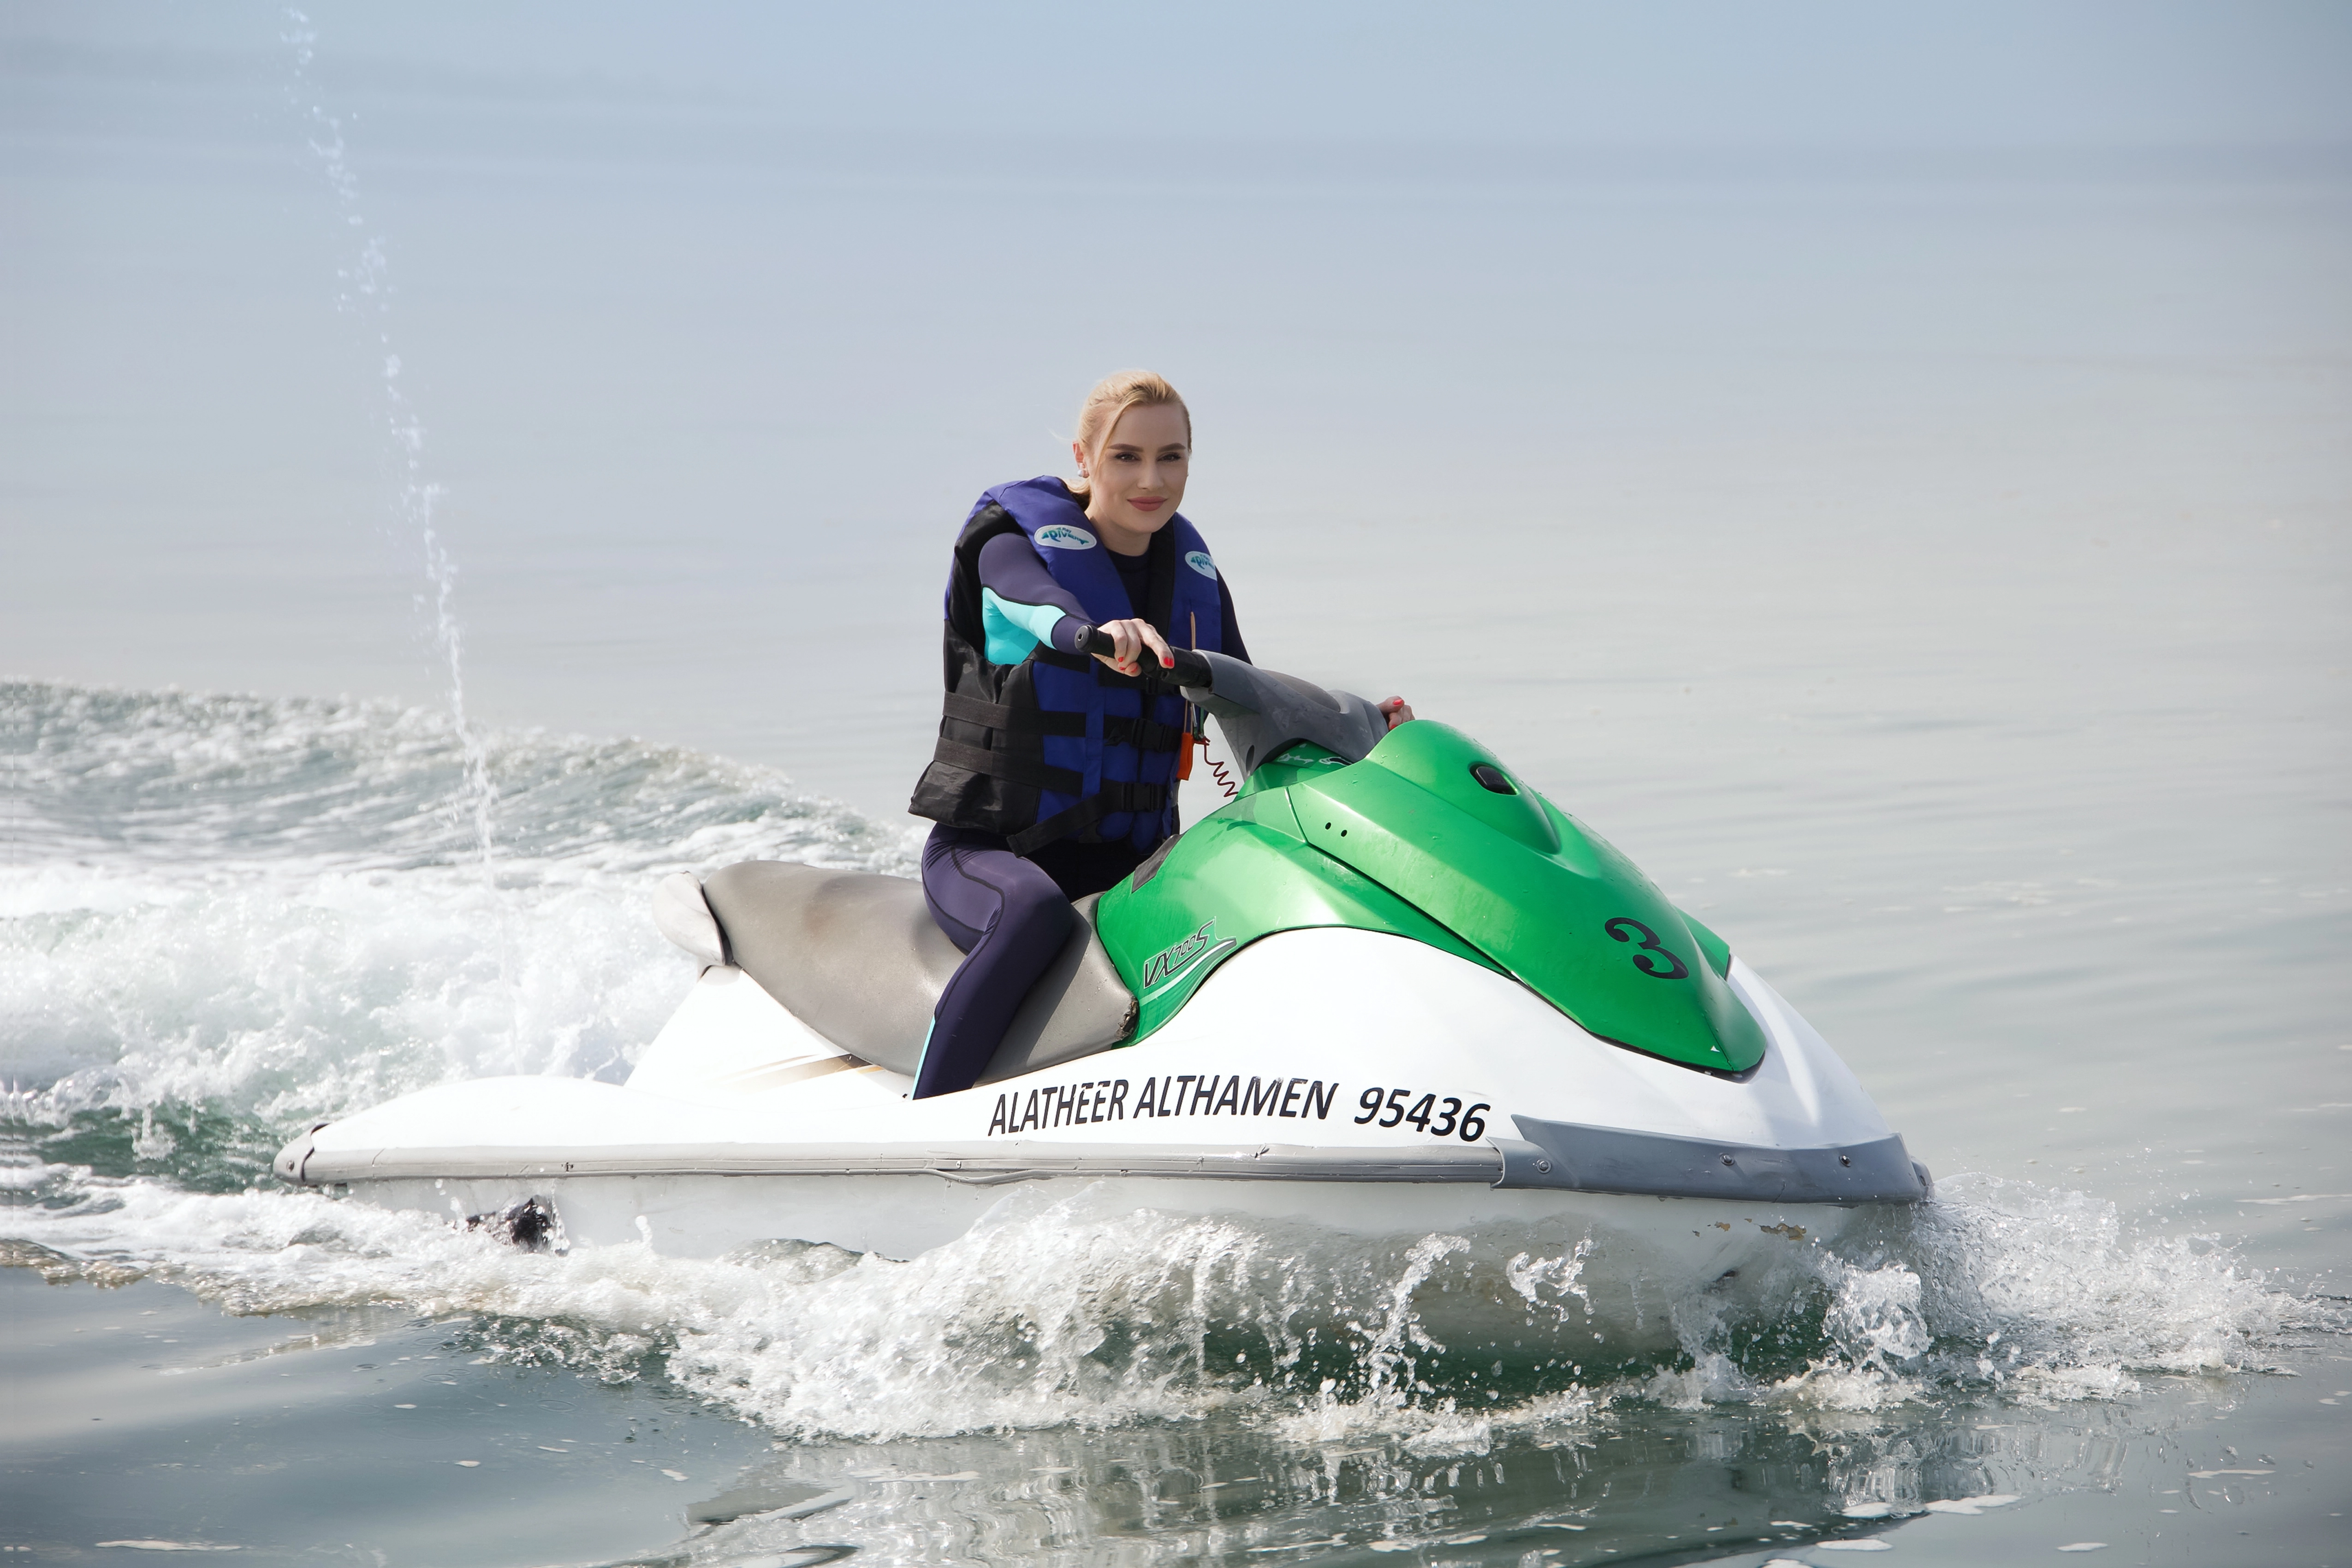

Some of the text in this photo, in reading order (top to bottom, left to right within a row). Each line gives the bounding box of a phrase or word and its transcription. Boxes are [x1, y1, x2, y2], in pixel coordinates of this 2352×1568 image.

[1144, 918, 1215, 989] VX700S
[1604, 917, 1689, 980] 3
[988, 1075, 1491, 1142] ALATHEER ALTHAMEN 95436
